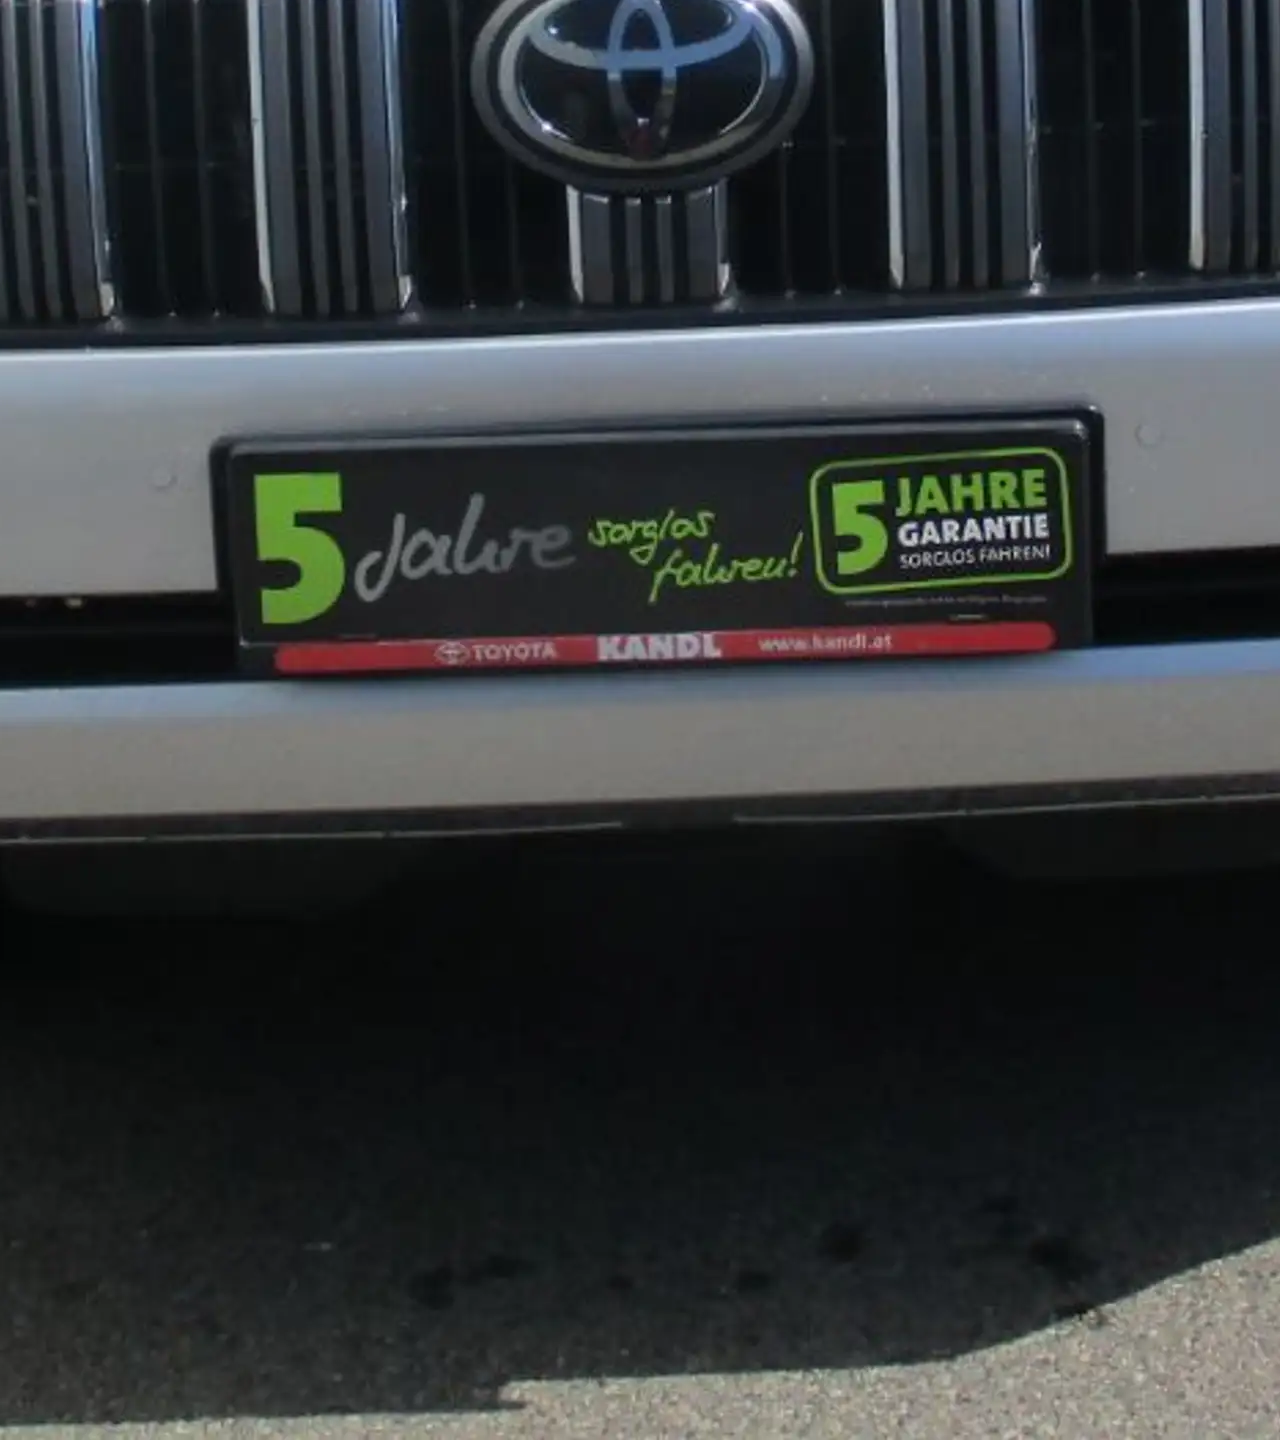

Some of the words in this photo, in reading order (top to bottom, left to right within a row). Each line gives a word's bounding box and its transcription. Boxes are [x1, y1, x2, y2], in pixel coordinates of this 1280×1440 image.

[254, 472, 345, 624] 5
[354, 492, 577, 602] Jahre
[588, 508, 716, 566] sorglos
[832, 479, 888, 575] 5
[895, 468, 1048, 517] JAHRE
[897, 513, 1050, 547] GARANTIE
[647, 530, 804, 605] fahren!
[900, 548, 975, 569] SORGLOS
[979, 543, 1051, 565] FAHREN!
[471, 641, 558, 661] TOYOTA
[597, 633, 723, 662] KANDL
[757, 631, 892, 654] www.kandl.at
